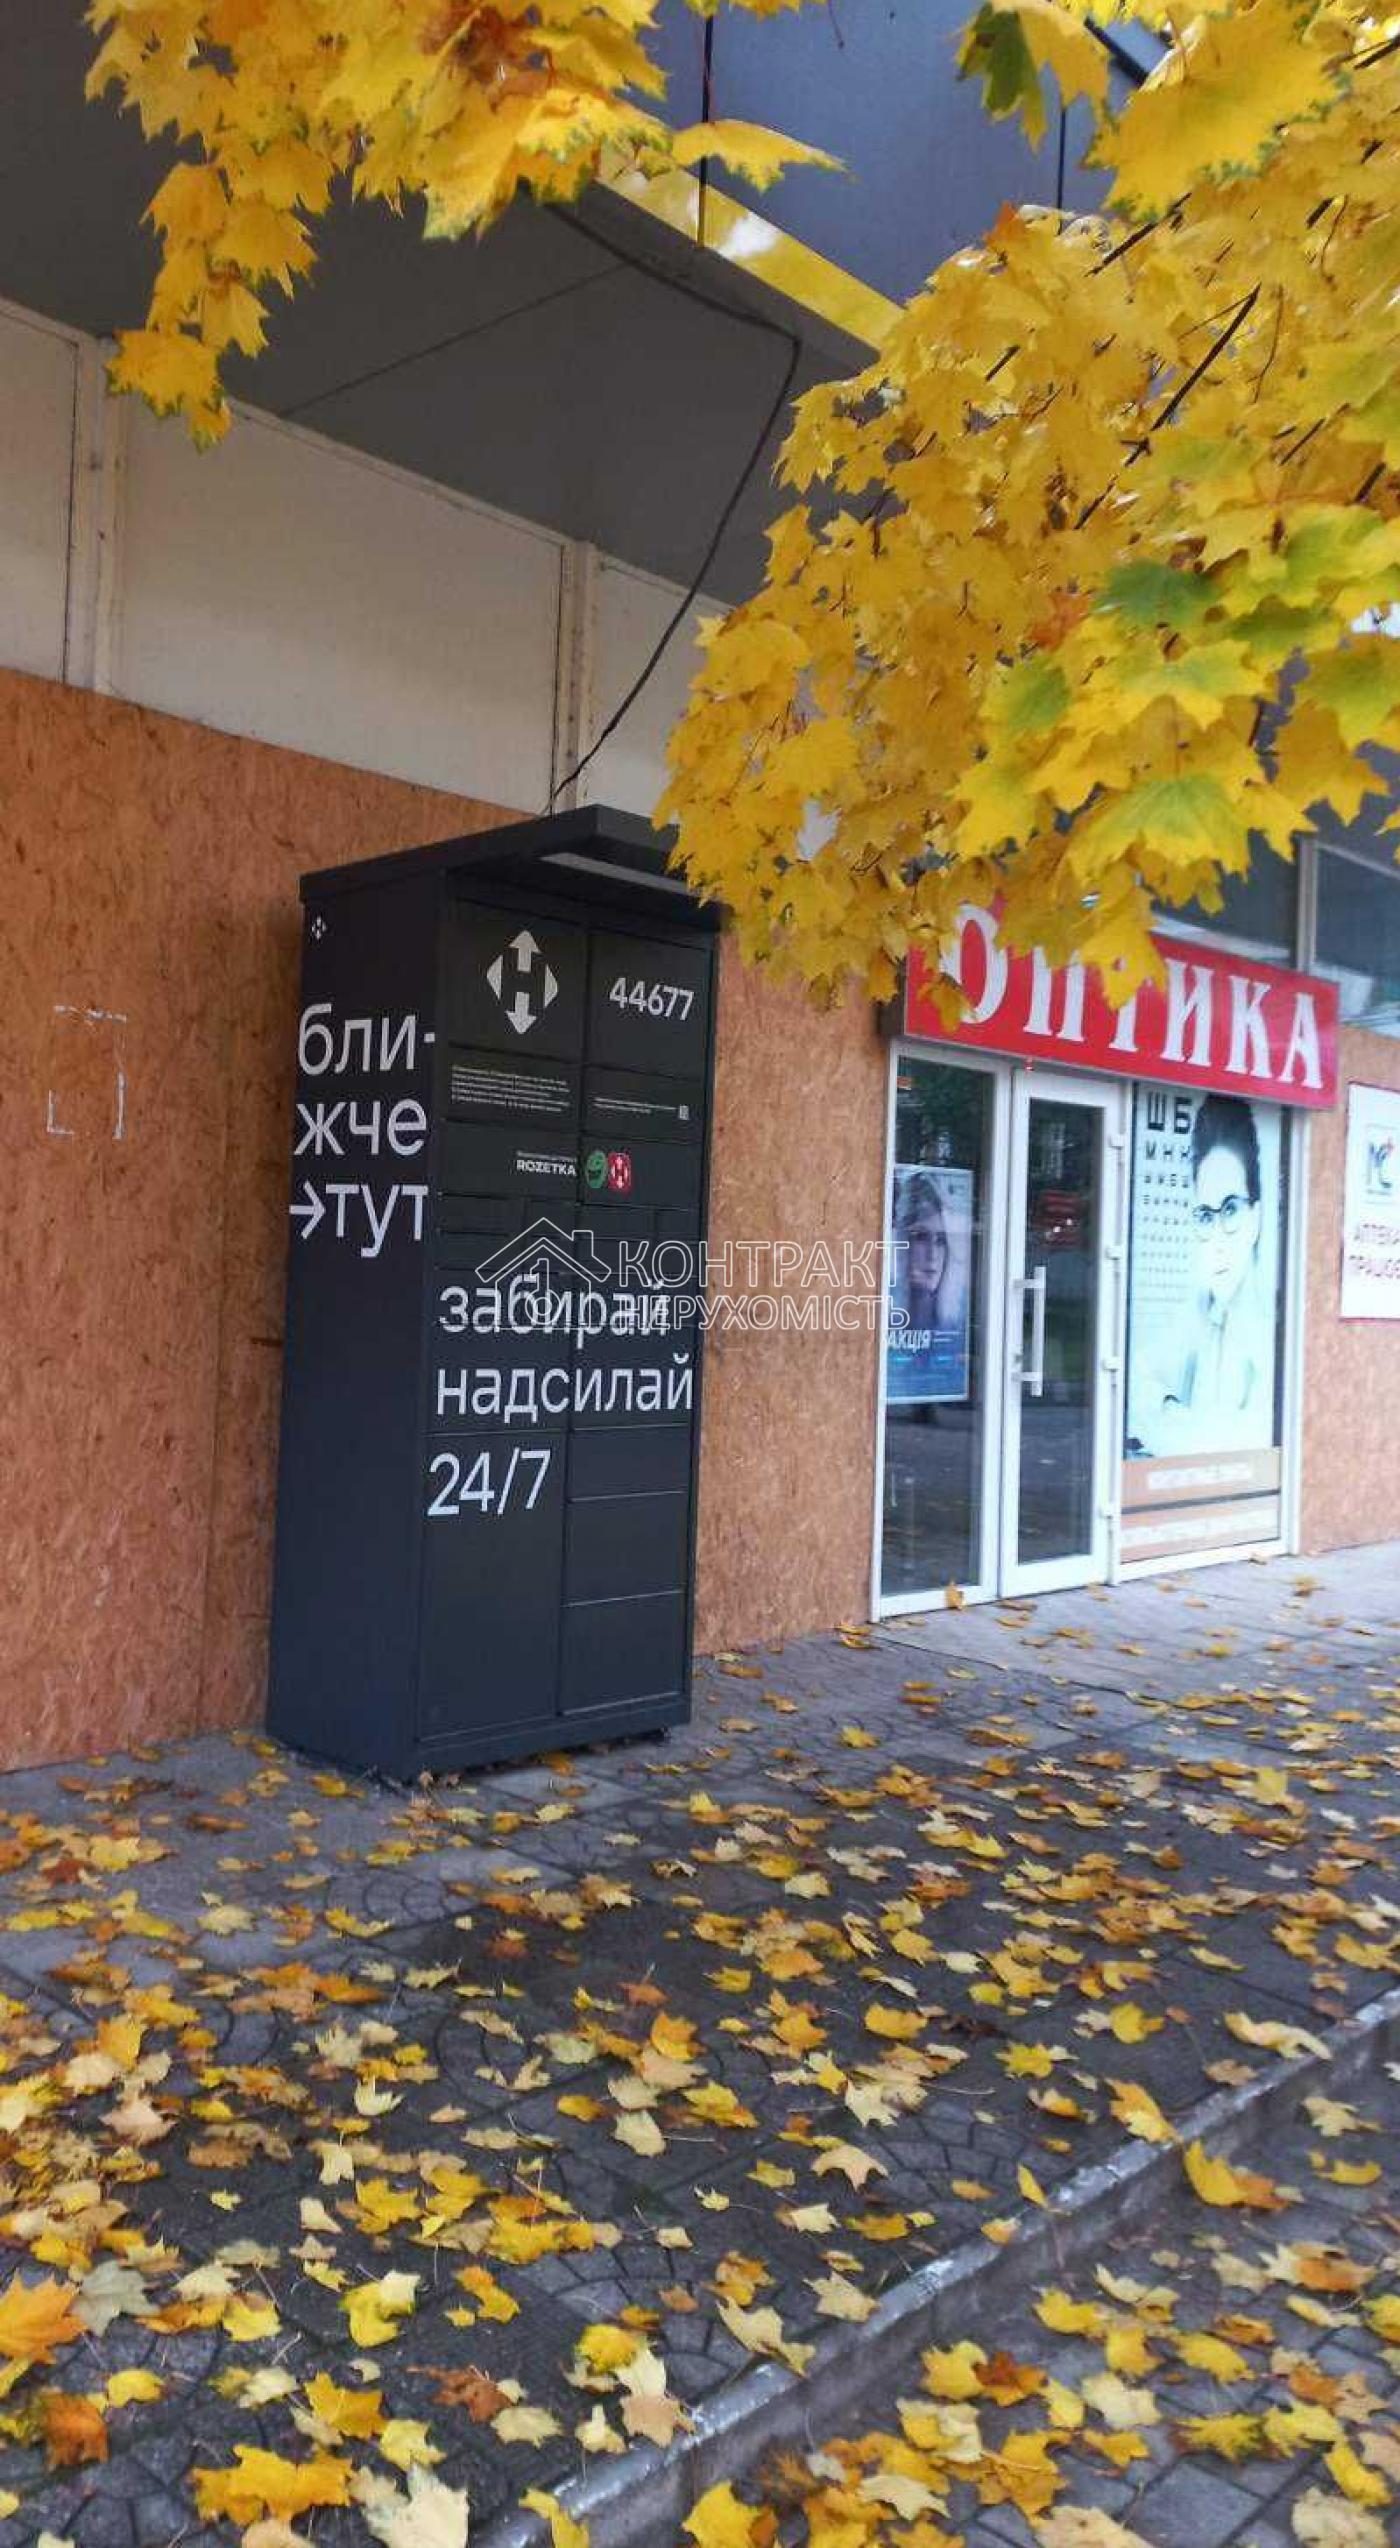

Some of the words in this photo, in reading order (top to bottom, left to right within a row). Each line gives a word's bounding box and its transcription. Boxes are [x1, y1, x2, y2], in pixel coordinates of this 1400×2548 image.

[609, 976, 695, 1021] 44677
[298, 1003, 436, 1076] бли-
[294, 1099, 428, 1156] жче
[516, 1159, 577, 1177] ROZETKA
[325, 1182, 430, 1259] тут
[438, 1273, 670, 1349] забирай
[437, 1352, 693, 1424] надсилай
[427, 1446, 552, 1517] 24/7
